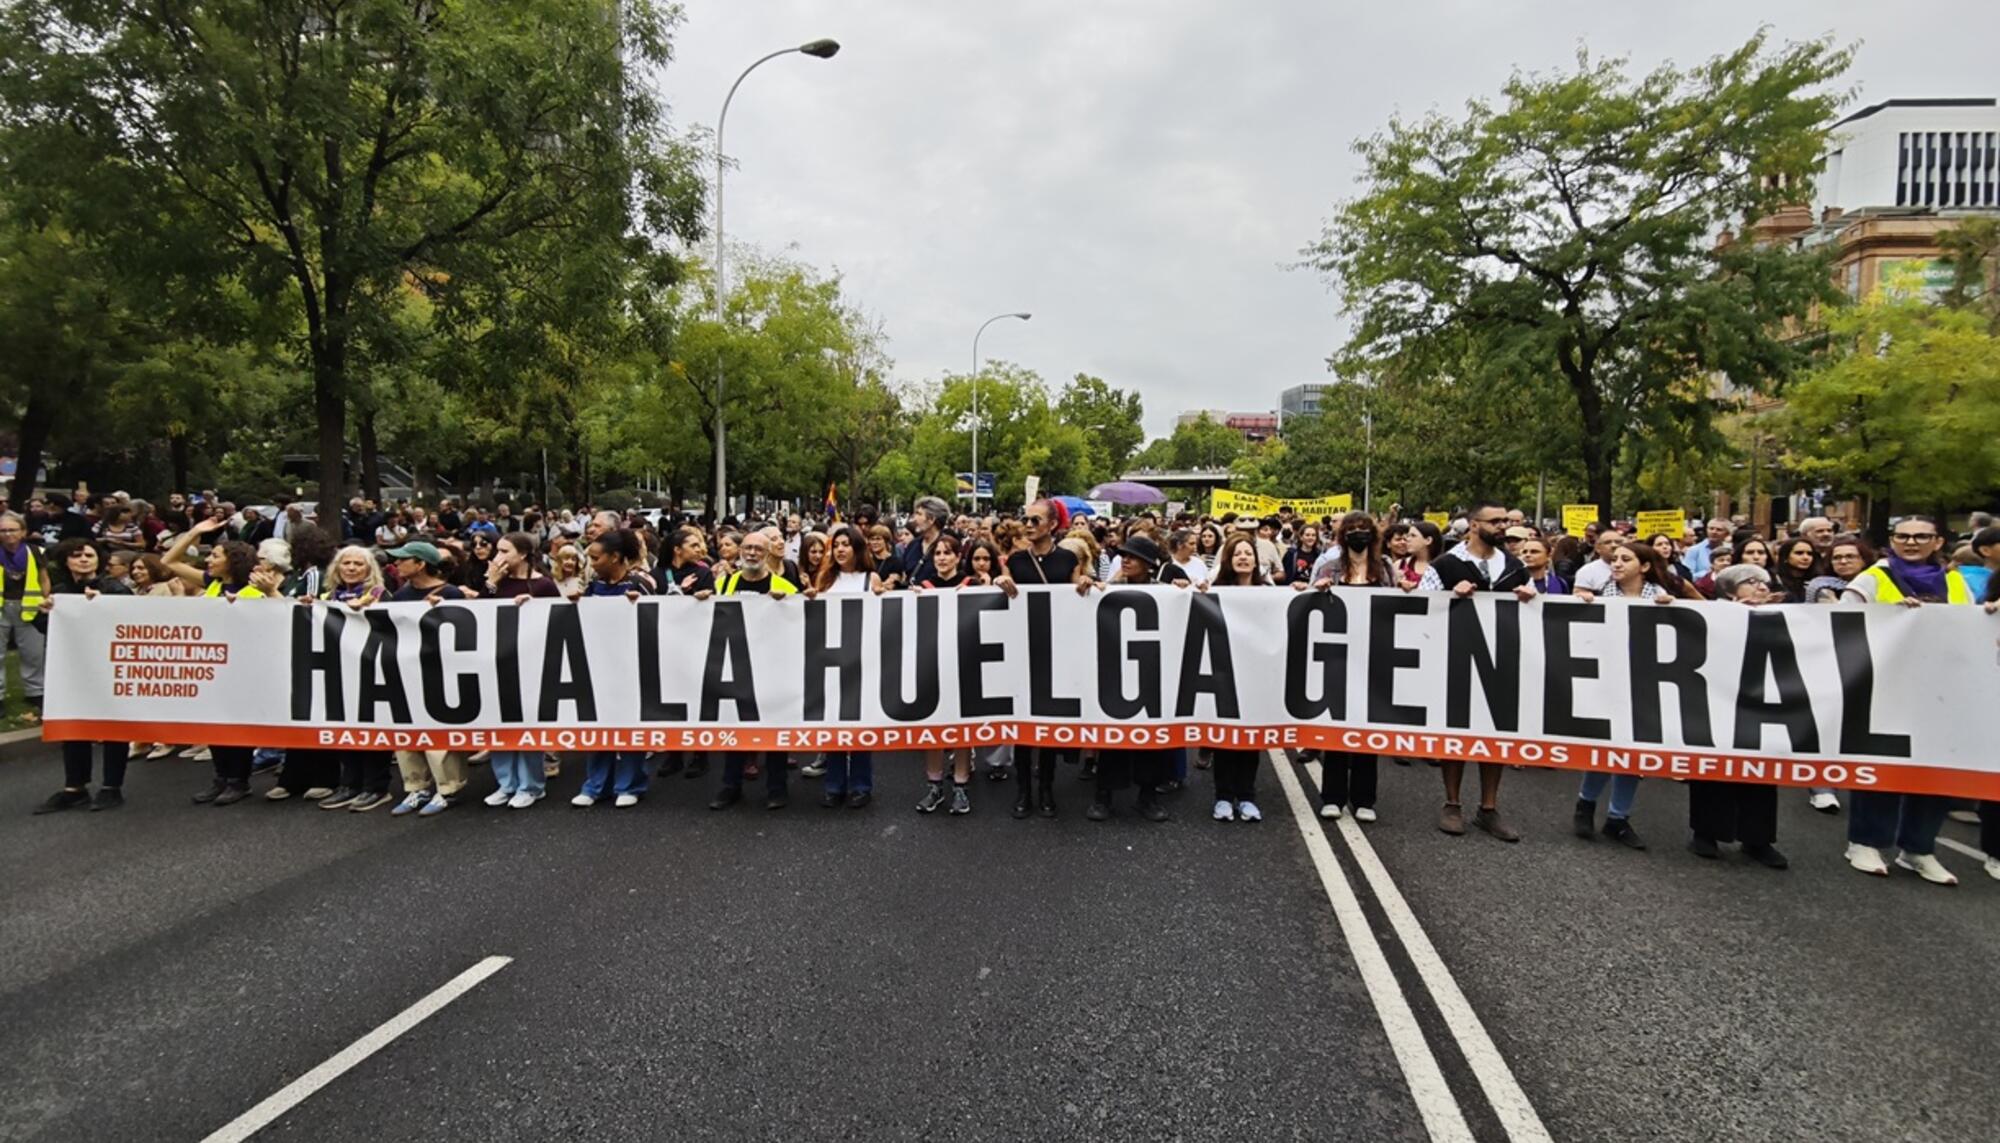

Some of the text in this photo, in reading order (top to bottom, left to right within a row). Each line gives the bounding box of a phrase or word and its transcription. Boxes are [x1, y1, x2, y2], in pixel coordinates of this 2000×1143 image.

[1217, 501, 1231, 509] UN
[115, 624, 202, 640] SINDICATO
[114, 644, 226, 662] DE INQUILINAS
[114, 665, 215, 681] E INQUILINOS
[291, 590, 1911, 758] HACIA LA HUELGA GENERAL
[113, 682, 198, 698] DE MADRID
[318, 730, 434, 747] BAJADA
[448, 731, 505, 746] DEL
[518, 730, 666, 750] ALQUILER
[681, 730, 738, 747] 50%
[776, 722, 1018, 747] EXPROPIACIÓN
[1035, 725, 1170, 745] FONDOS
[1185, 726, 1298, 745] BUITRE
[1342, 731, 1570, 764] CONTRATOS
[1591, 749, 1878, 785] INDEFINIDOS
